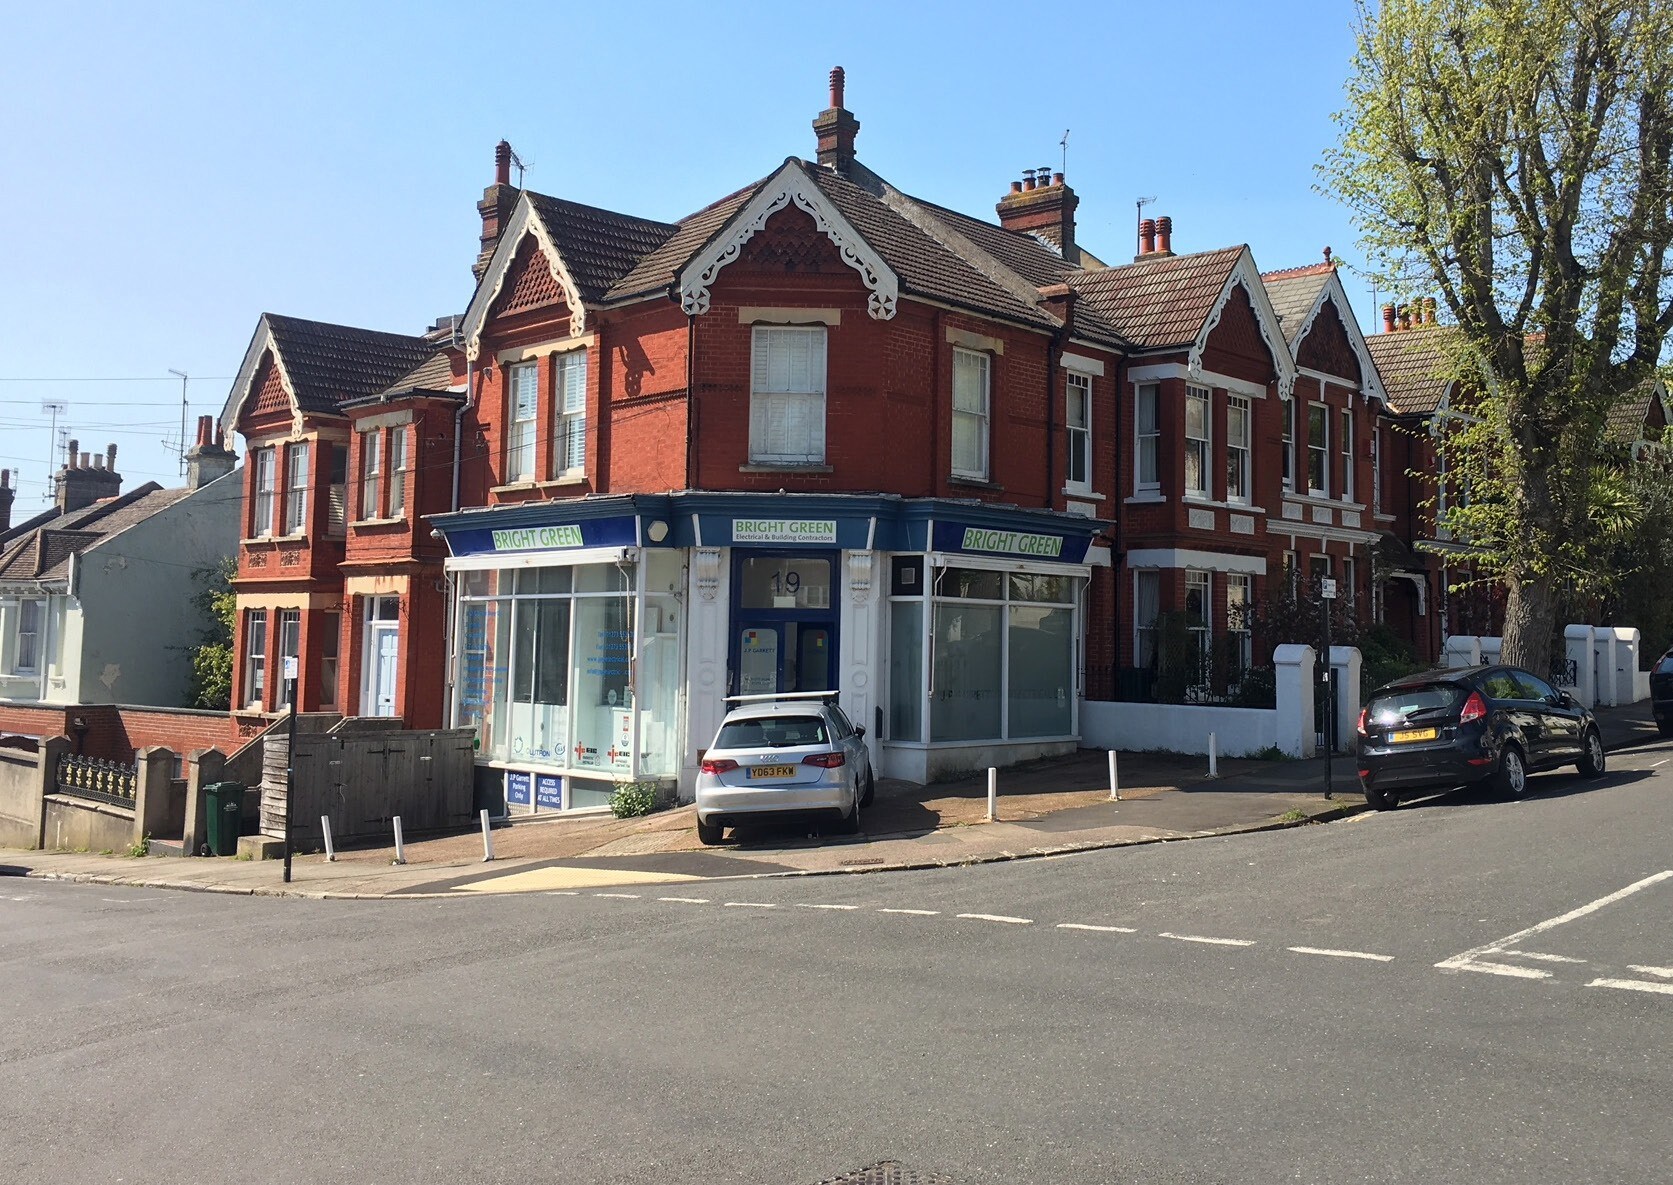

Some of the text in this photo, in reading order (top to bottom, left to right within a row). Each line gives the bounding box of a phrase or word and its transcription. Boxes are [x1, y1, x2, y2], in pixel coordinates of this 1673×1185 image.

[736, 521, 833, 534] BRIGHT GREEN
[493, 526, 582, 549] BRIGHT GREEN
[771, 533, 797, 542] Building
[963, 528, 1061, 555] BRIGHT GREEN
[771, 571, 800, 593] 19
[752, 766, 794, 777] YD63 FKW
[512, 782, 527, 792] Parking
[541, 778, 556, 786] ACCESS
[514, 791, 524, 801] Only
